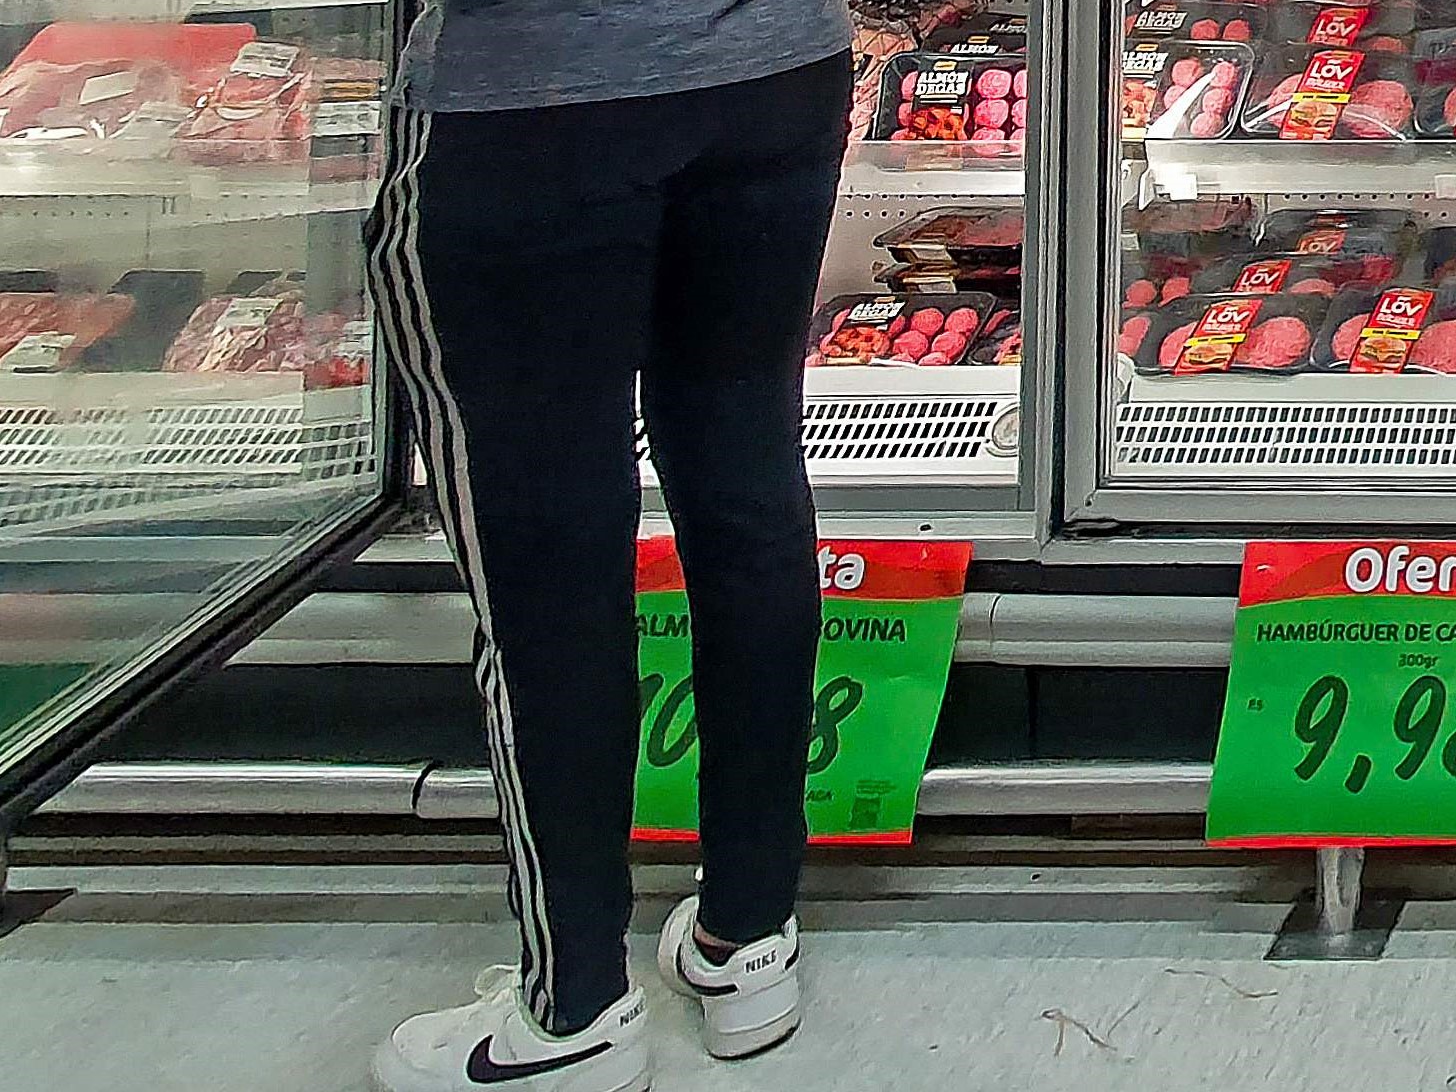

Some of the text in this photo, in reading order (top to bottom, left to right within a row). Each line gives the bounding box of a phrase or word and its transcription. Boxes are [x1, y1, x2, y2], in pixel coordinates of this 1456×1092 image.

[820, 618, 907, 642] OVINA
[1256, 619, 1399, 642] HAMBÚRGUER
[1405, 623, 1431, 642] DE
[745, 949, 777, 974] NIKE
